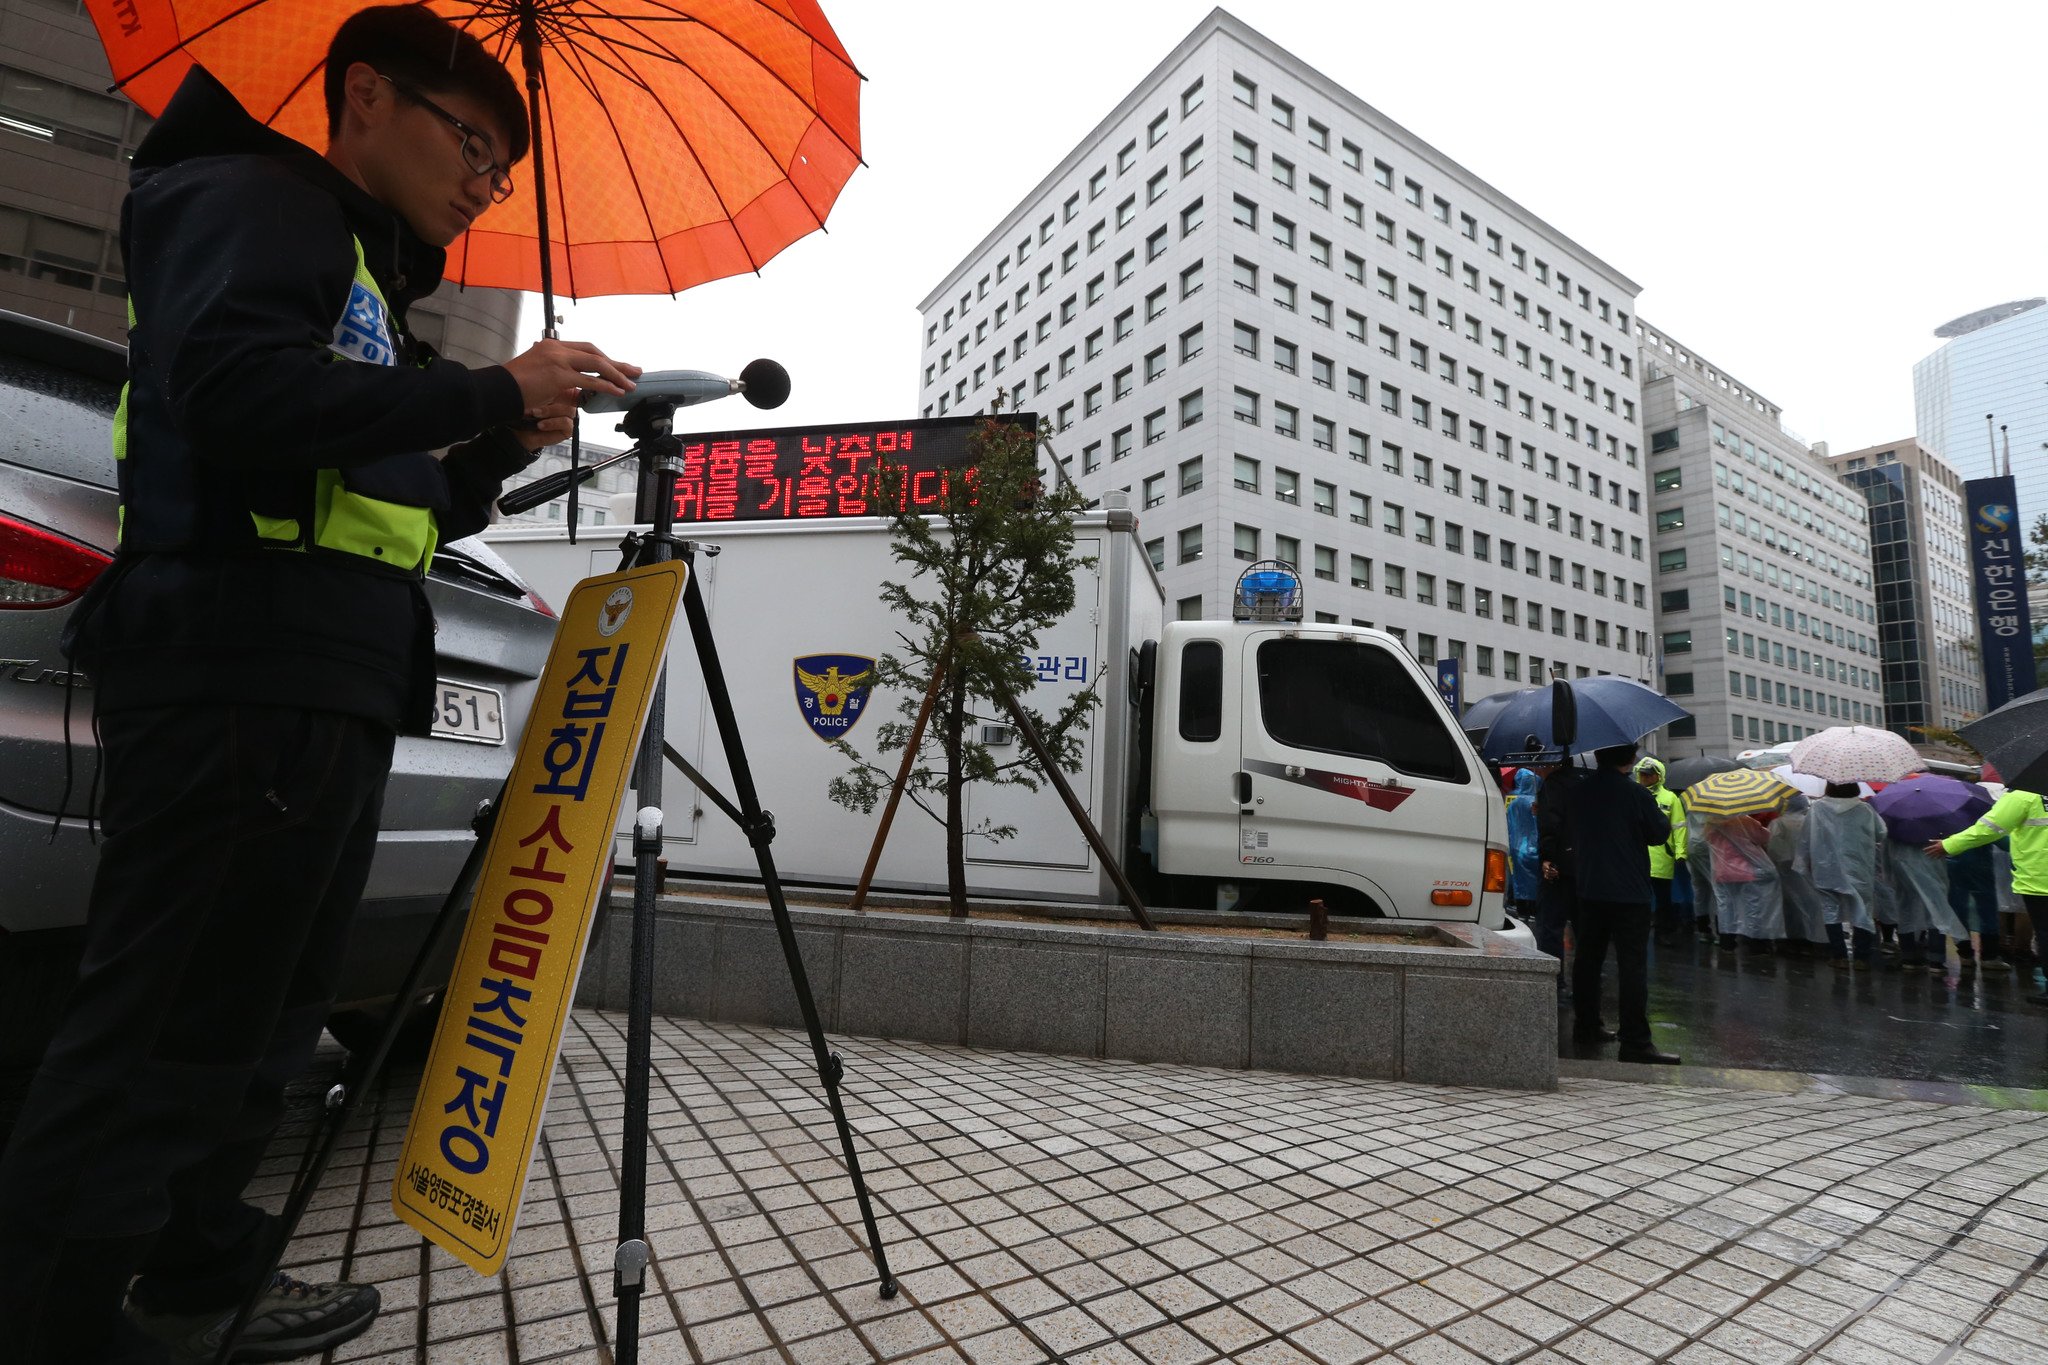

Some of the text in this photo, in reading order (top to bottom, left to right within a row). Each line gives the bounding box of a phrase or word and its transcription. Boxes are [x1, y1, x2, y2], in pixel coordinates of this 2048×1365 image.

[673, 480, 738, 519] 귀를
[1981, 538, 2019, 637] 신한은행
[813, 717, 848, 727] POLICE
[1333, 776, 1368, 788] MIGHTY
[407, 1162, 501, 1240] 서울영등포경찰서
